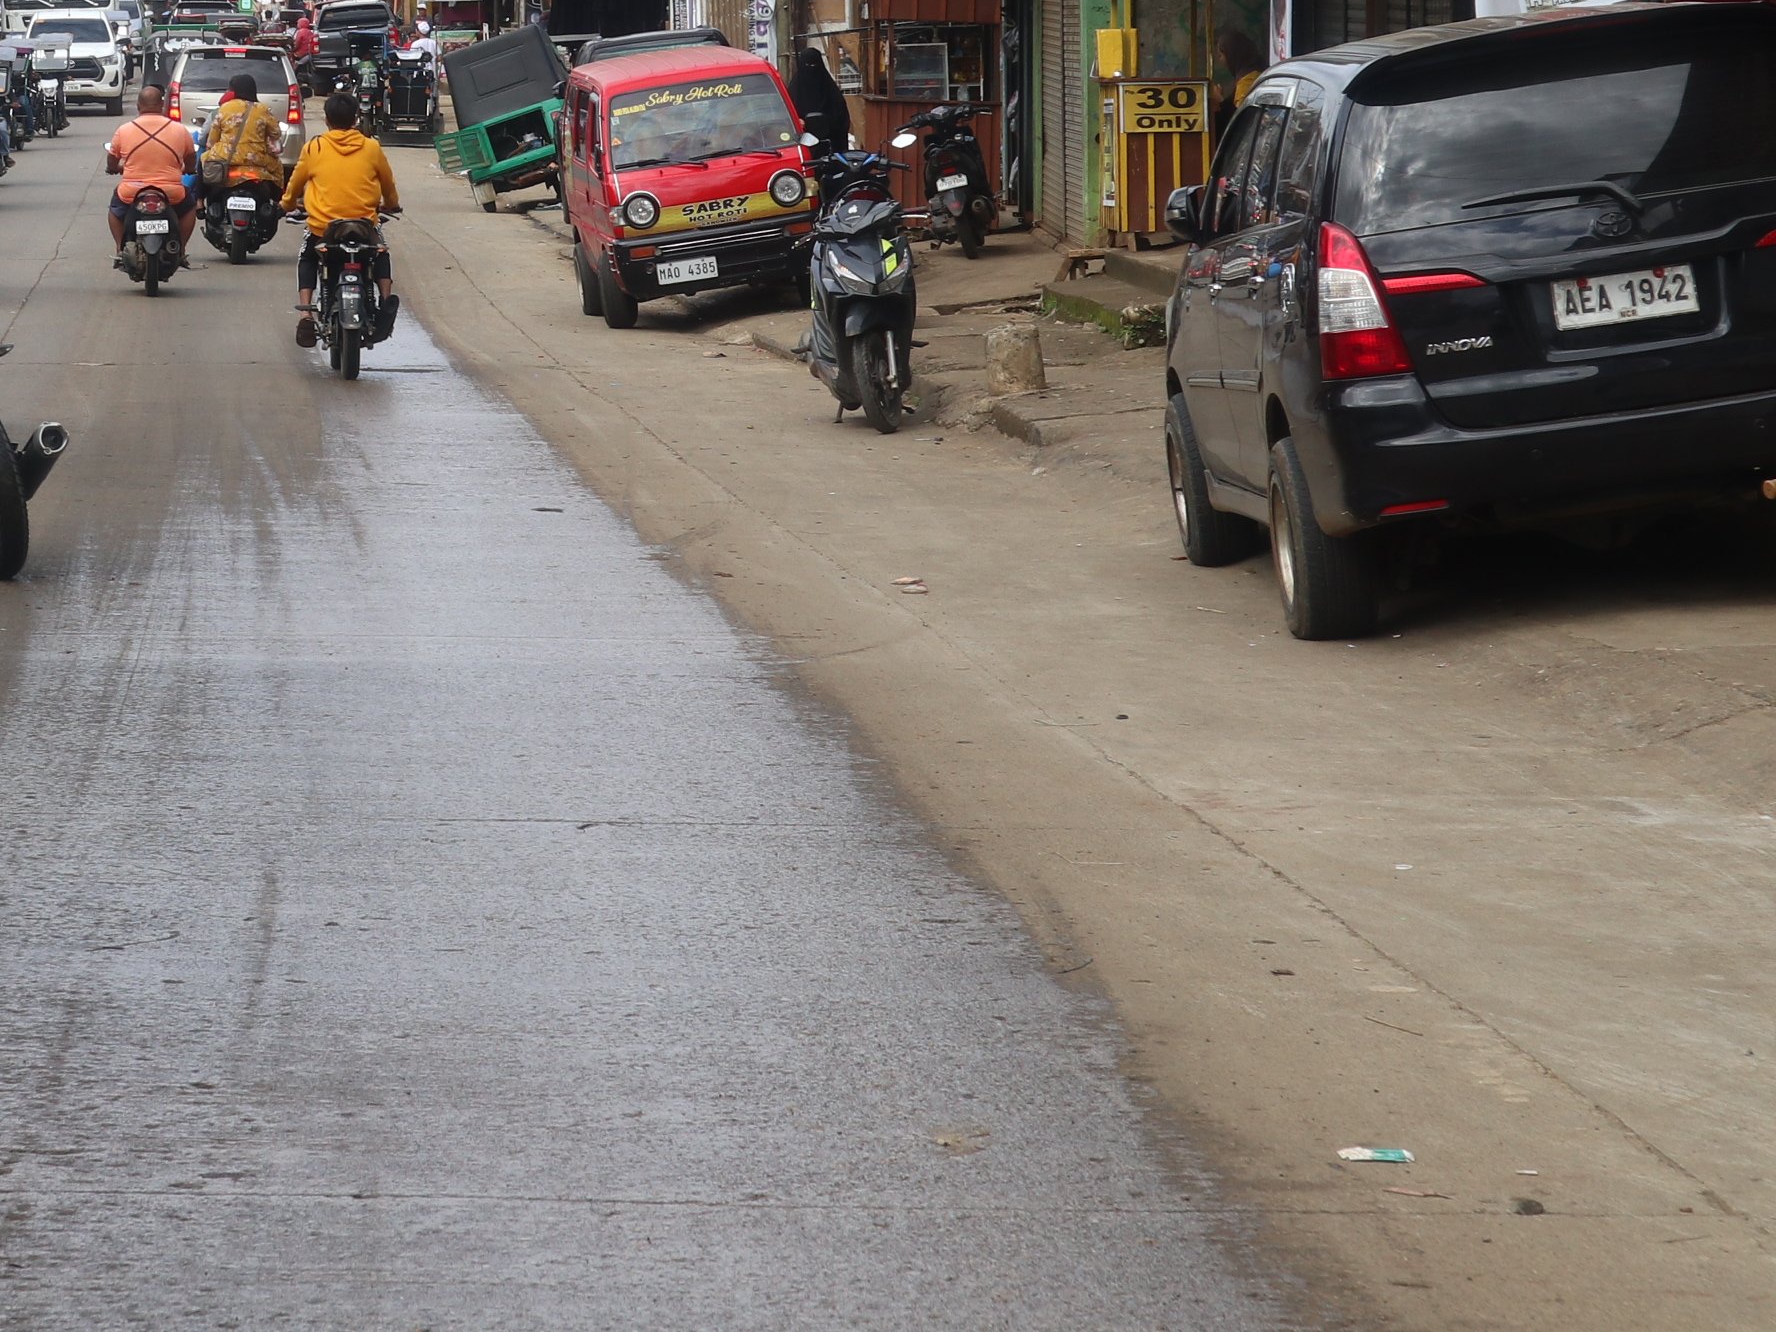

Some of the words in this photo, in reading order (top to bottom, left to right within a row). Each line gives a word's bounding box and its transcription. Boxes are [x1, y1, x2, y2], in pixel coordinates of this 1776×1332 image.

[645, 90, 684, 108] Sabry
[684, 86, 713, 102] Hot
[713, 83, 743, 99] Roti
[1136, 87, 1197, 110] 30
[1136, 115, 1199, 131] Only
[682, 195, 750, 217] SABRY
[688, 214, 712, 224] HOT
[717, 207, 748, 220] ROTI
[687, 261, 717, 276] 4385
[1564, 282, 1613, 317] AEA
[1623, 272, 1690, 308] 1942
[1426, 335, 1494, 356] INNOVA
